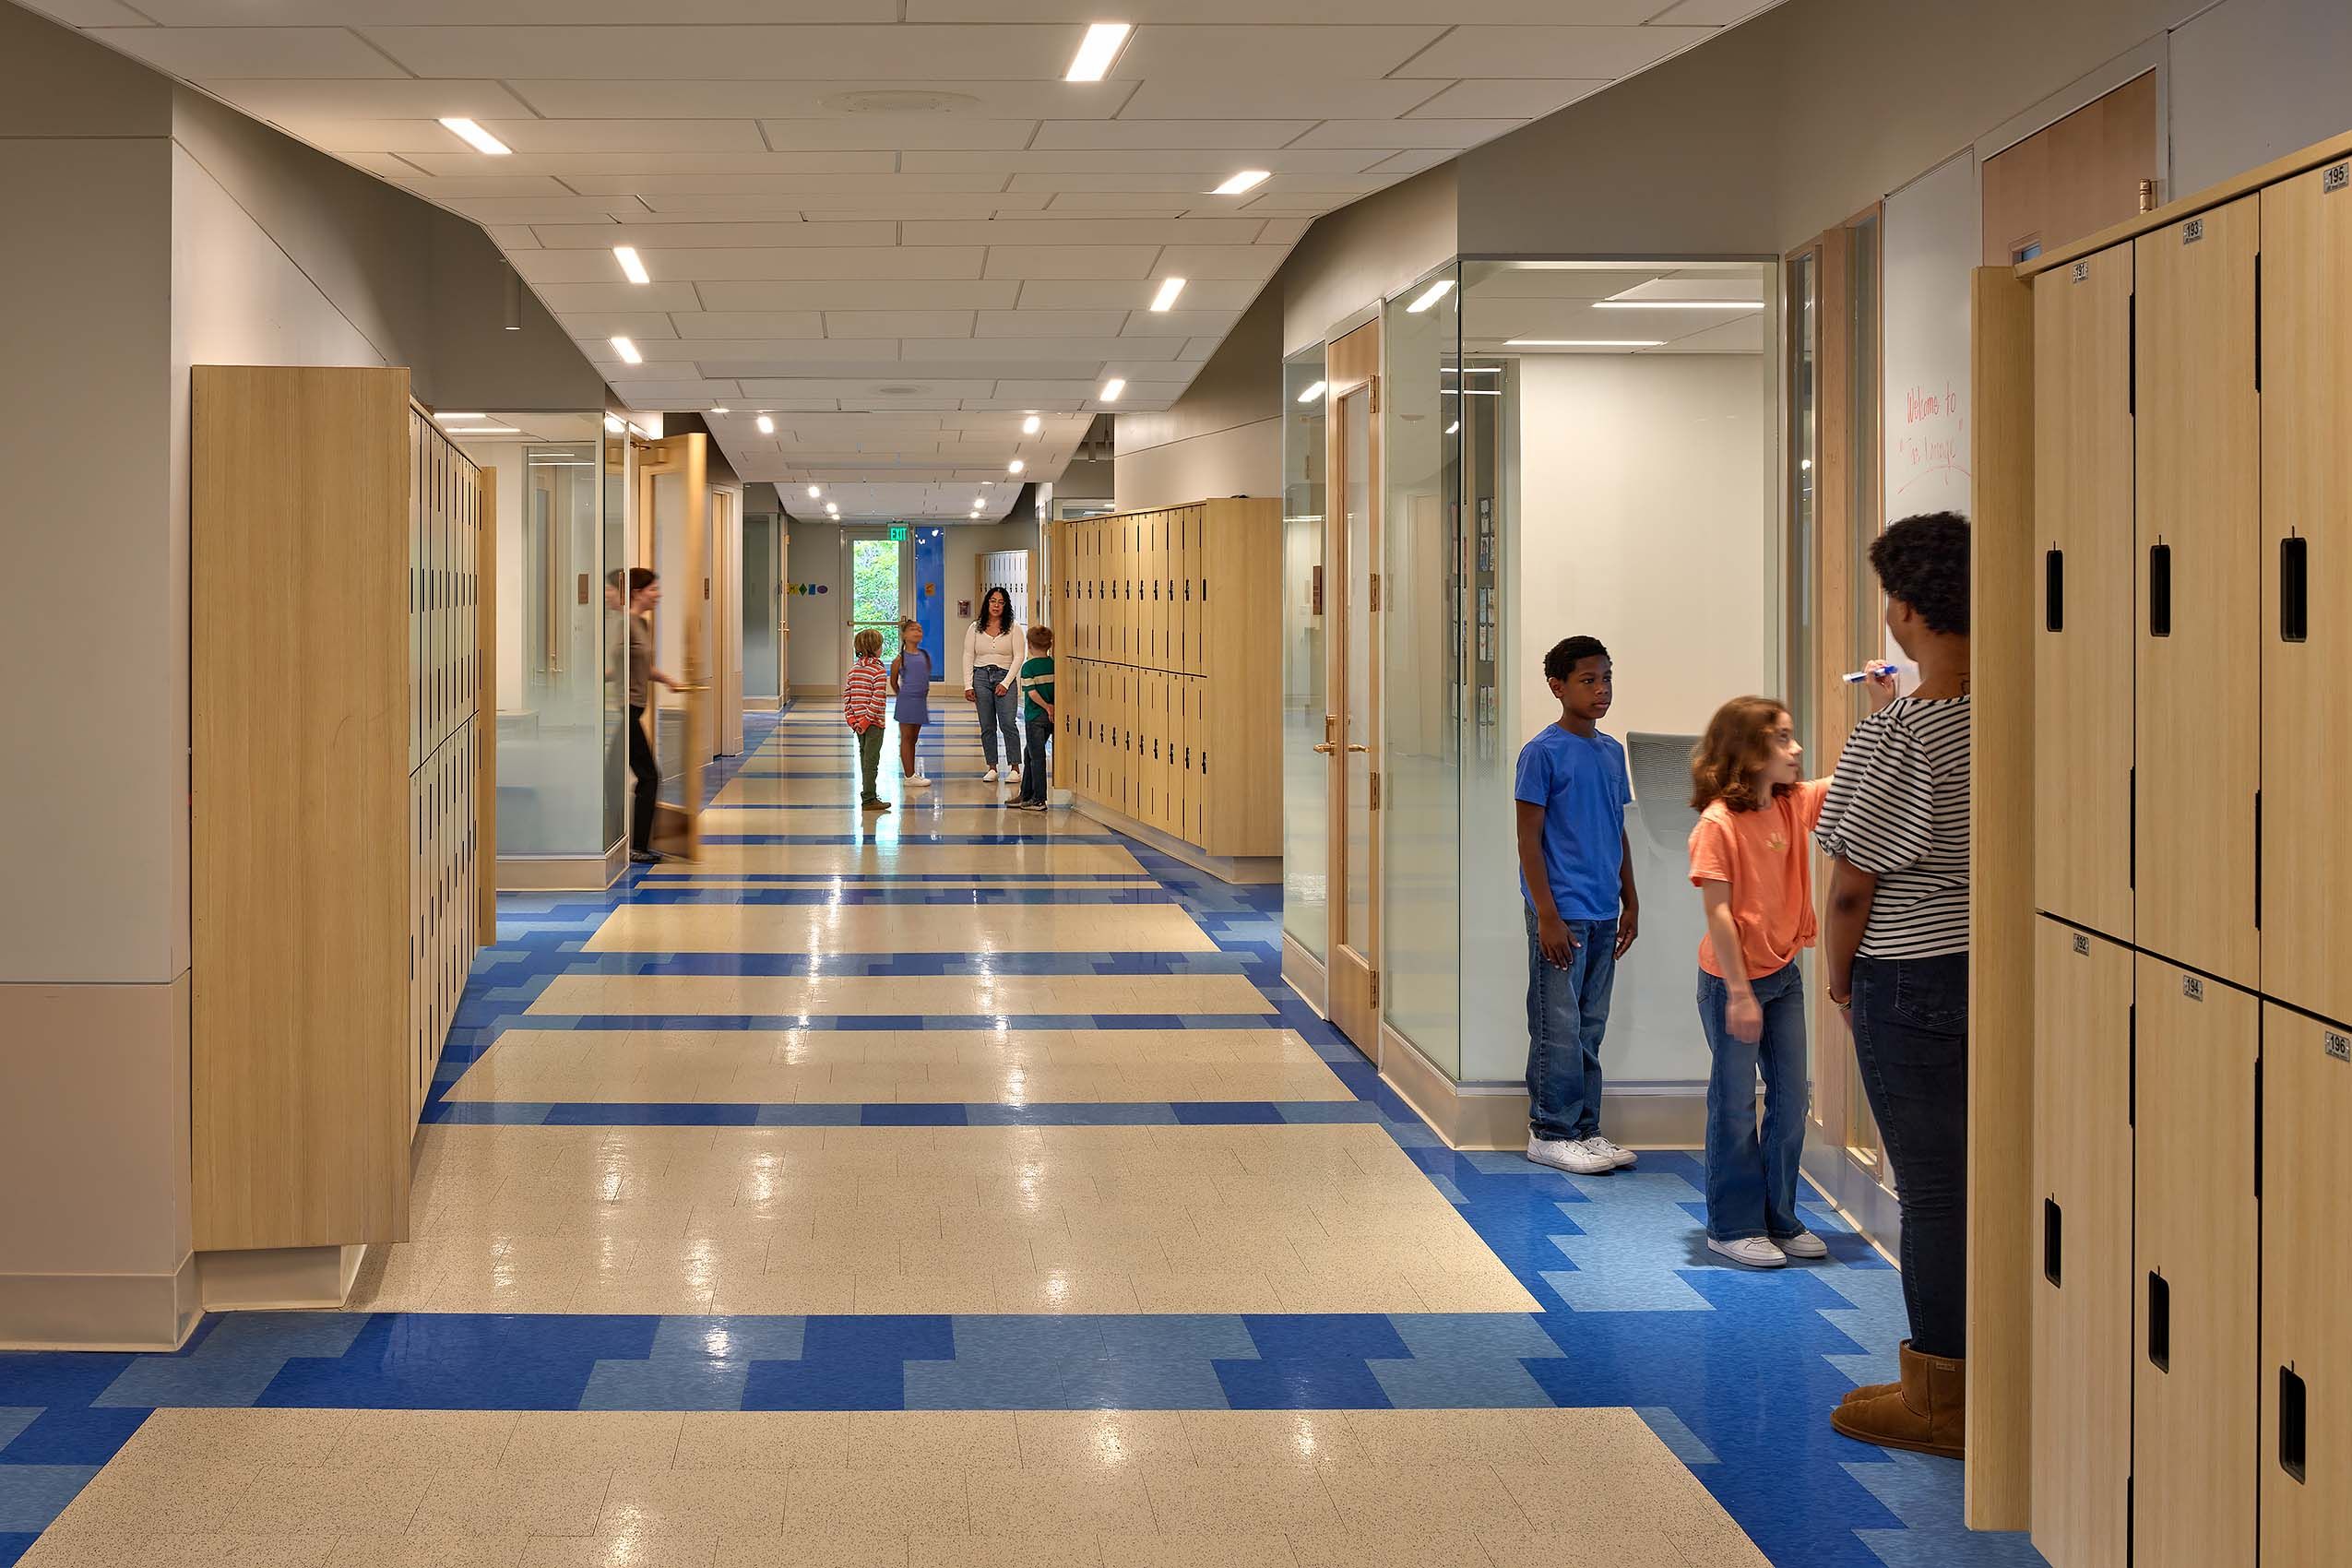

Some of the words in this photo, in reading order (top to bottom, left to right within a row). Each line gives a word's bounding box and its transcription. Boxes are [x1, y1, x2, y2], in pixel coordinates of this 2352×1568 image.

[2329, 165, 2345, 184] 195
[2187, 221, 2199, 237] 193
[2075, 263, 2085, 278] 191
[1907, 386, 1940, 423] Welcome
[1943, 381, 1956, 417] to
[890, 526, 908, 540] EXIT
[2076, 935, 2086, 950] 192
[2187, 978, 2199, 994] 194
[2331, 1035, 2346, 1054] 196
